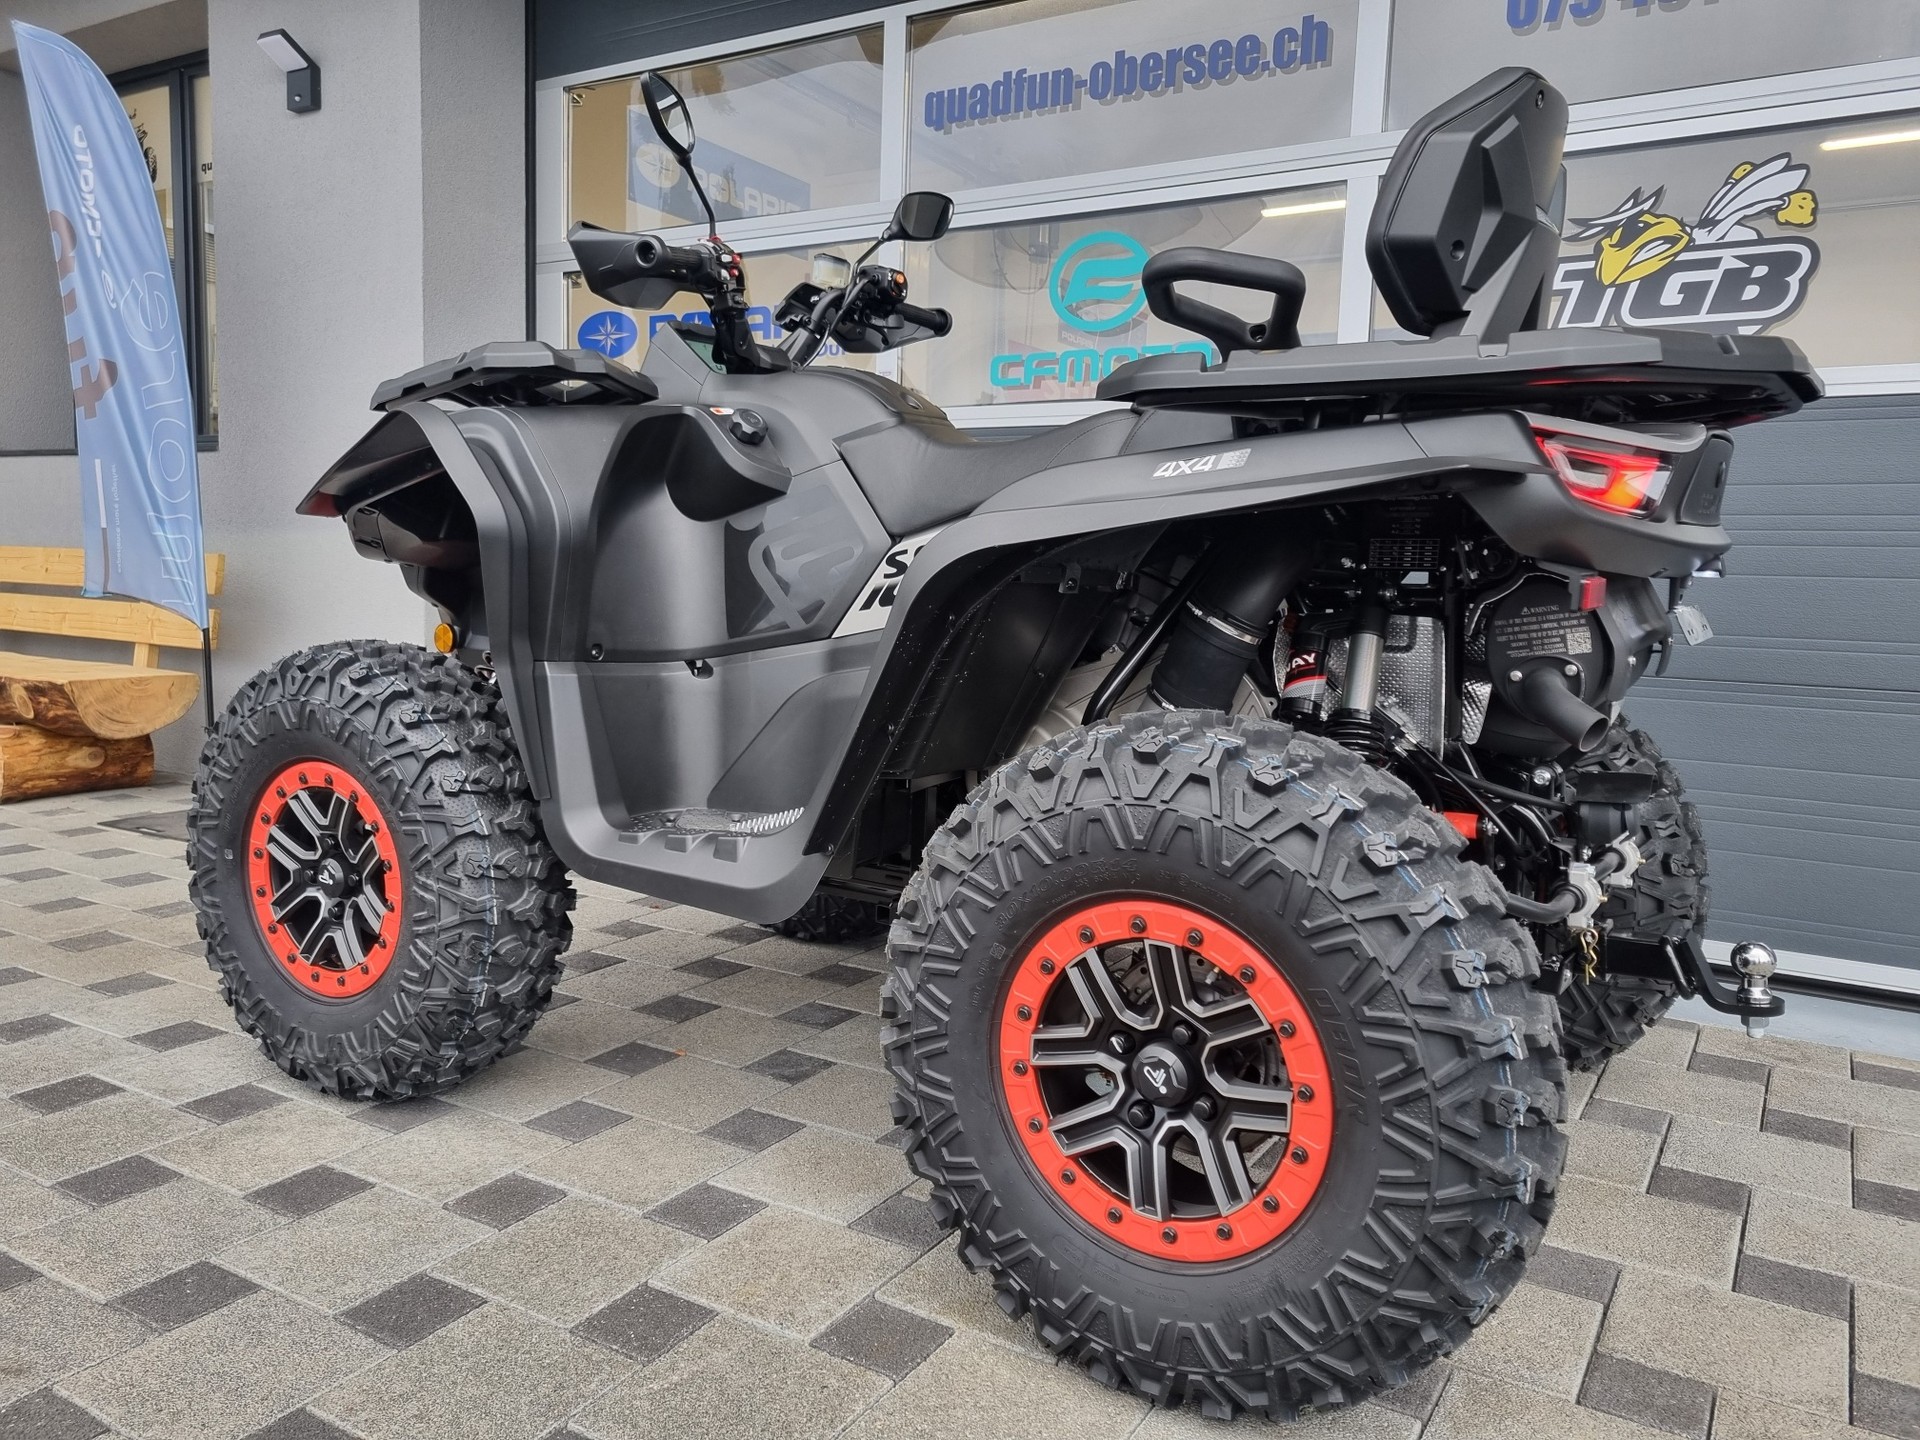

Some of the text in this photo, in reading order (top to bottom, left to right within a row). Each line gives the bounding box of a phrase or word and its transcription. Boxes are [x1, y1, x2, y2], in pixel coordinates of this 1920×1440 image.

[924, 14, 1330, 131] quadfun-obersee.ch
[1553, 243, 1812, 328] TGB
[990, 341, 1213, 388] CFMOO
